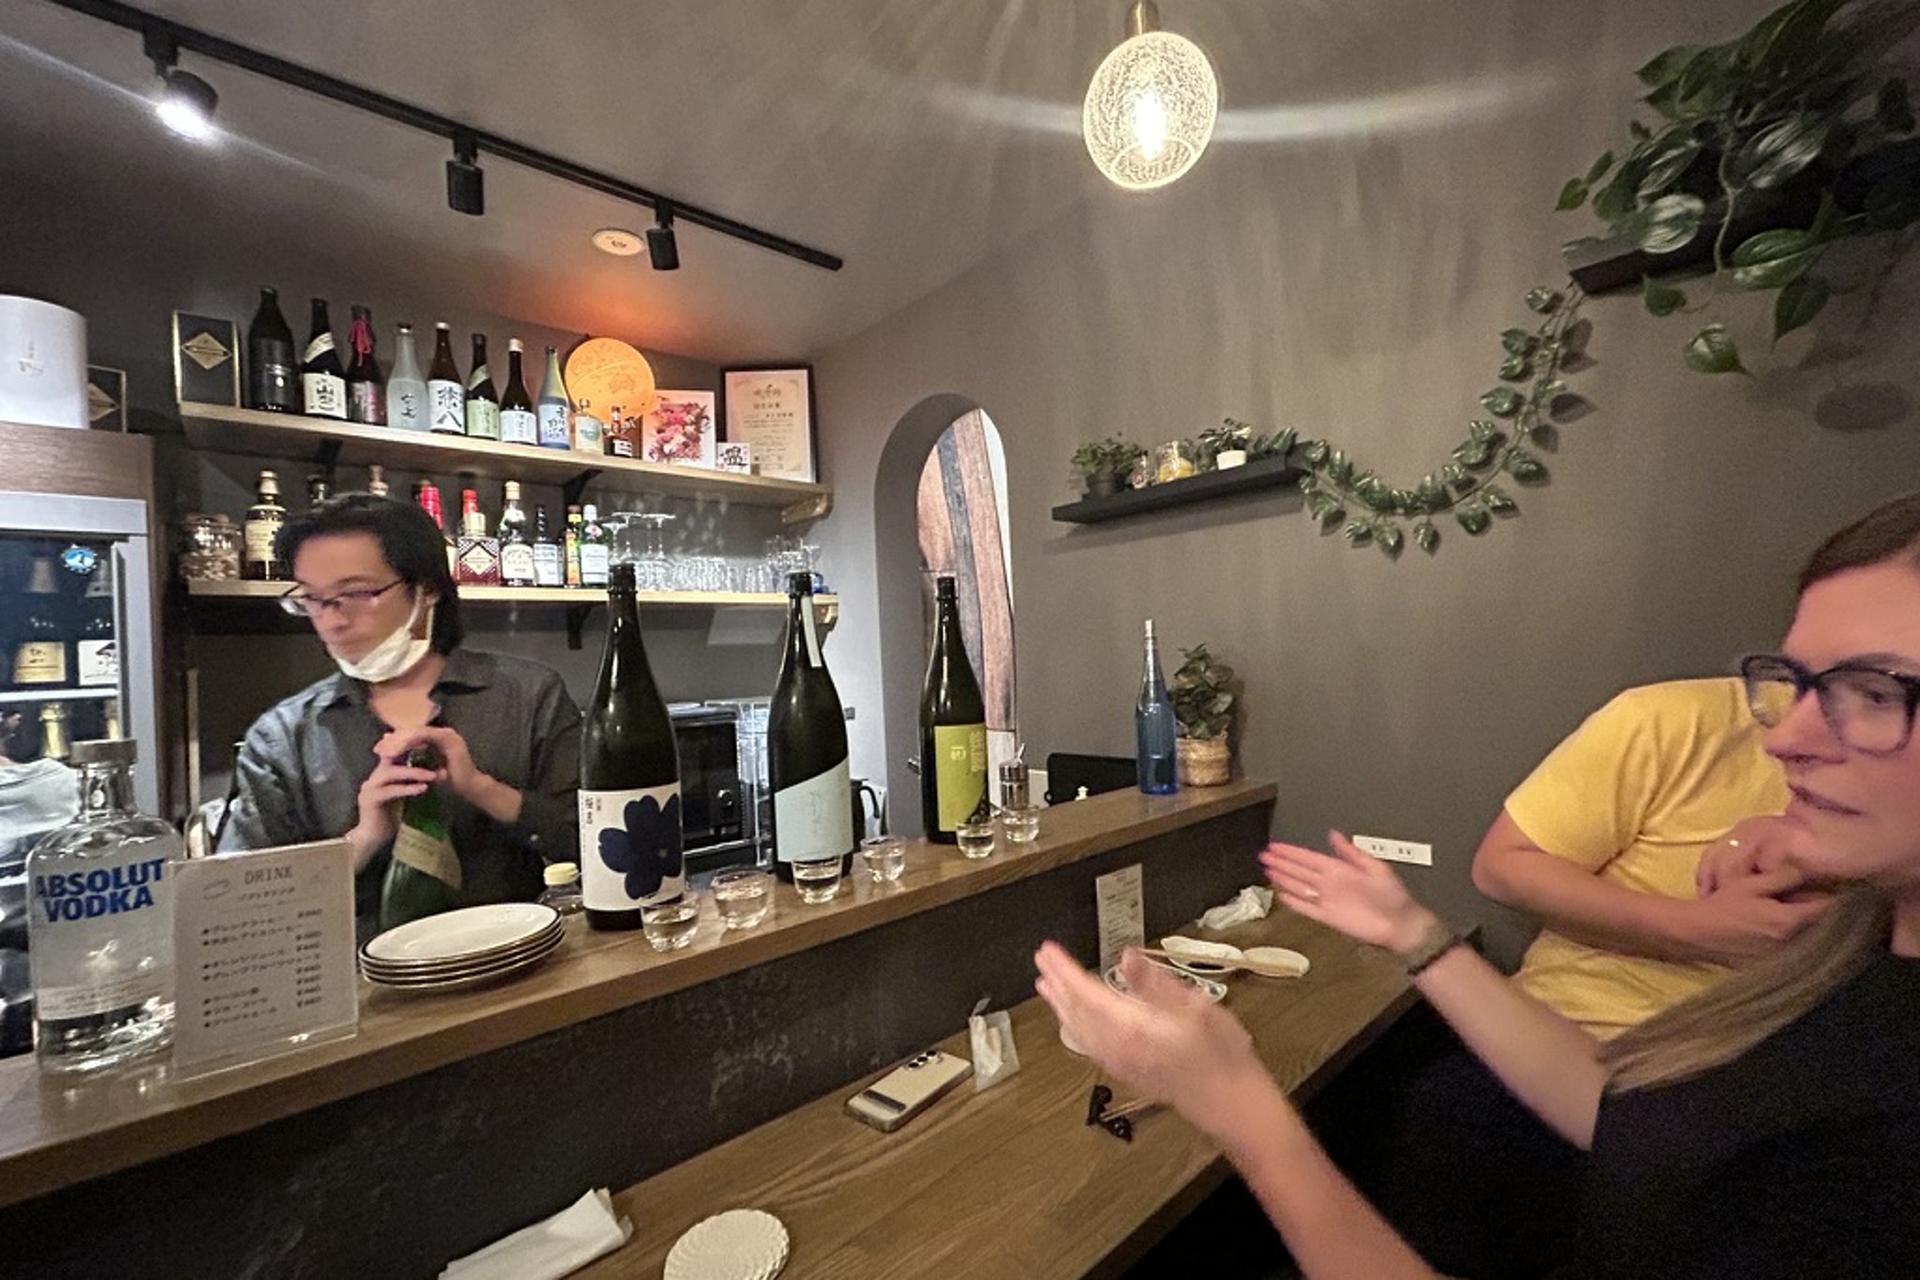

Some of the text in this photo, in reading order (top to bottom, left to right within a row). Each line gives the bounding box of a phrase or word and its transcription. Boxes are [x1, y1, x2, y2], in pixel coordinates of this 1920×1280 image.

[37, 859, 165, 898] ABSOLUT
[244, 865, 294, 884] DRINK
[45, 885, 155, 922] VODKA
